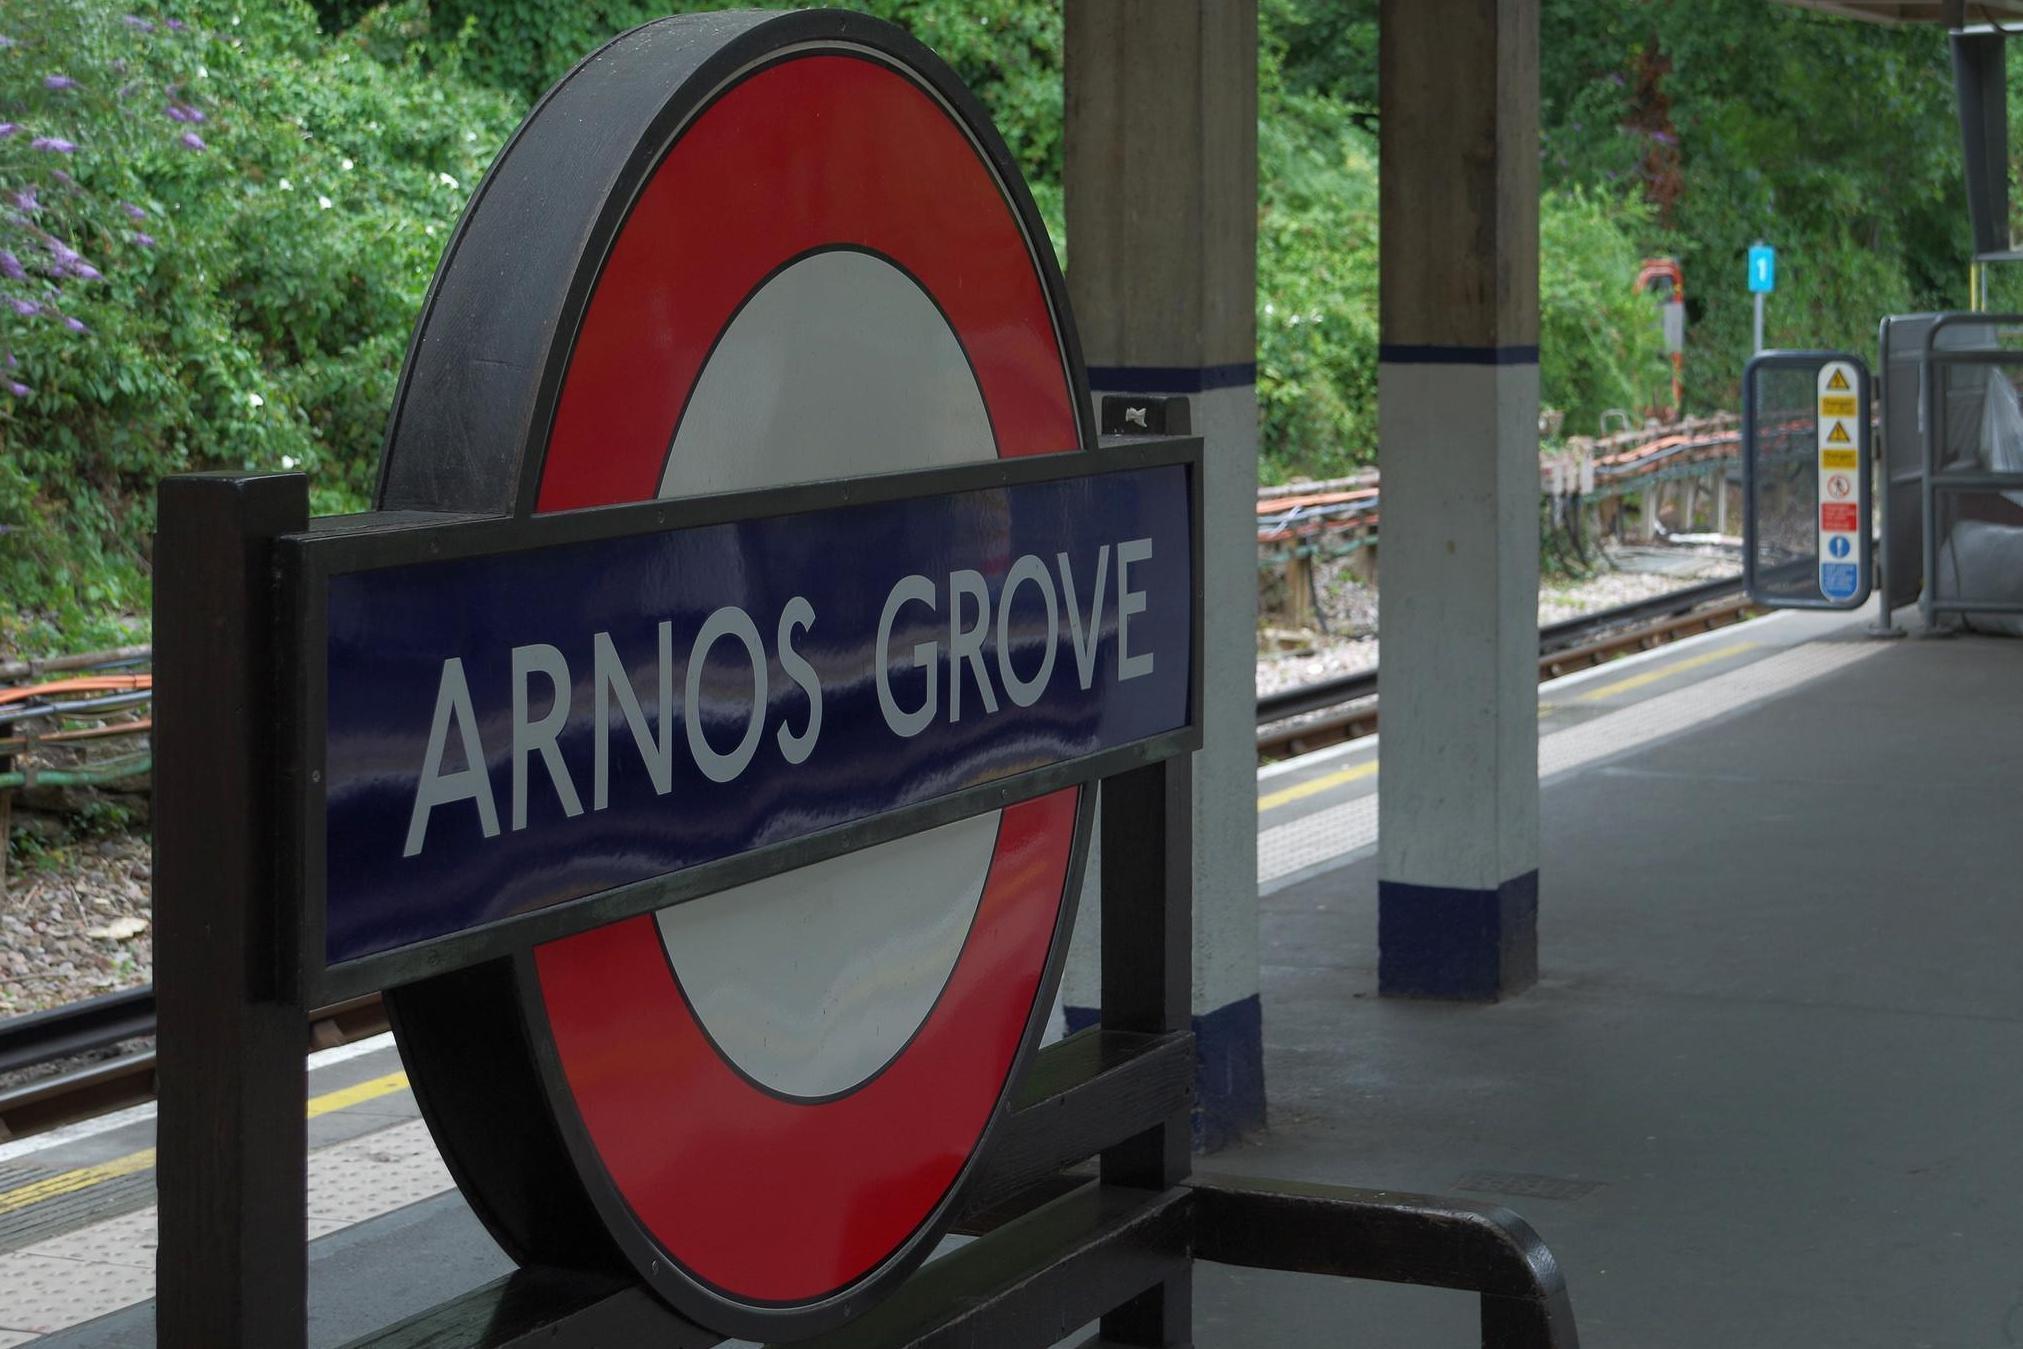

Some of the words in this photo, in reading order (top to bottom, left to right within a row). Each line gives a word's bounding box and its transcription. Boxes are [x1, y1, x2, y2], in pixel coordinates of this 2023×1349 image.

[1756, 256, 1766, 281] 1
[403, 597, 823, 857] ARNOS
[876, 538, 1154, 738] GROVE
